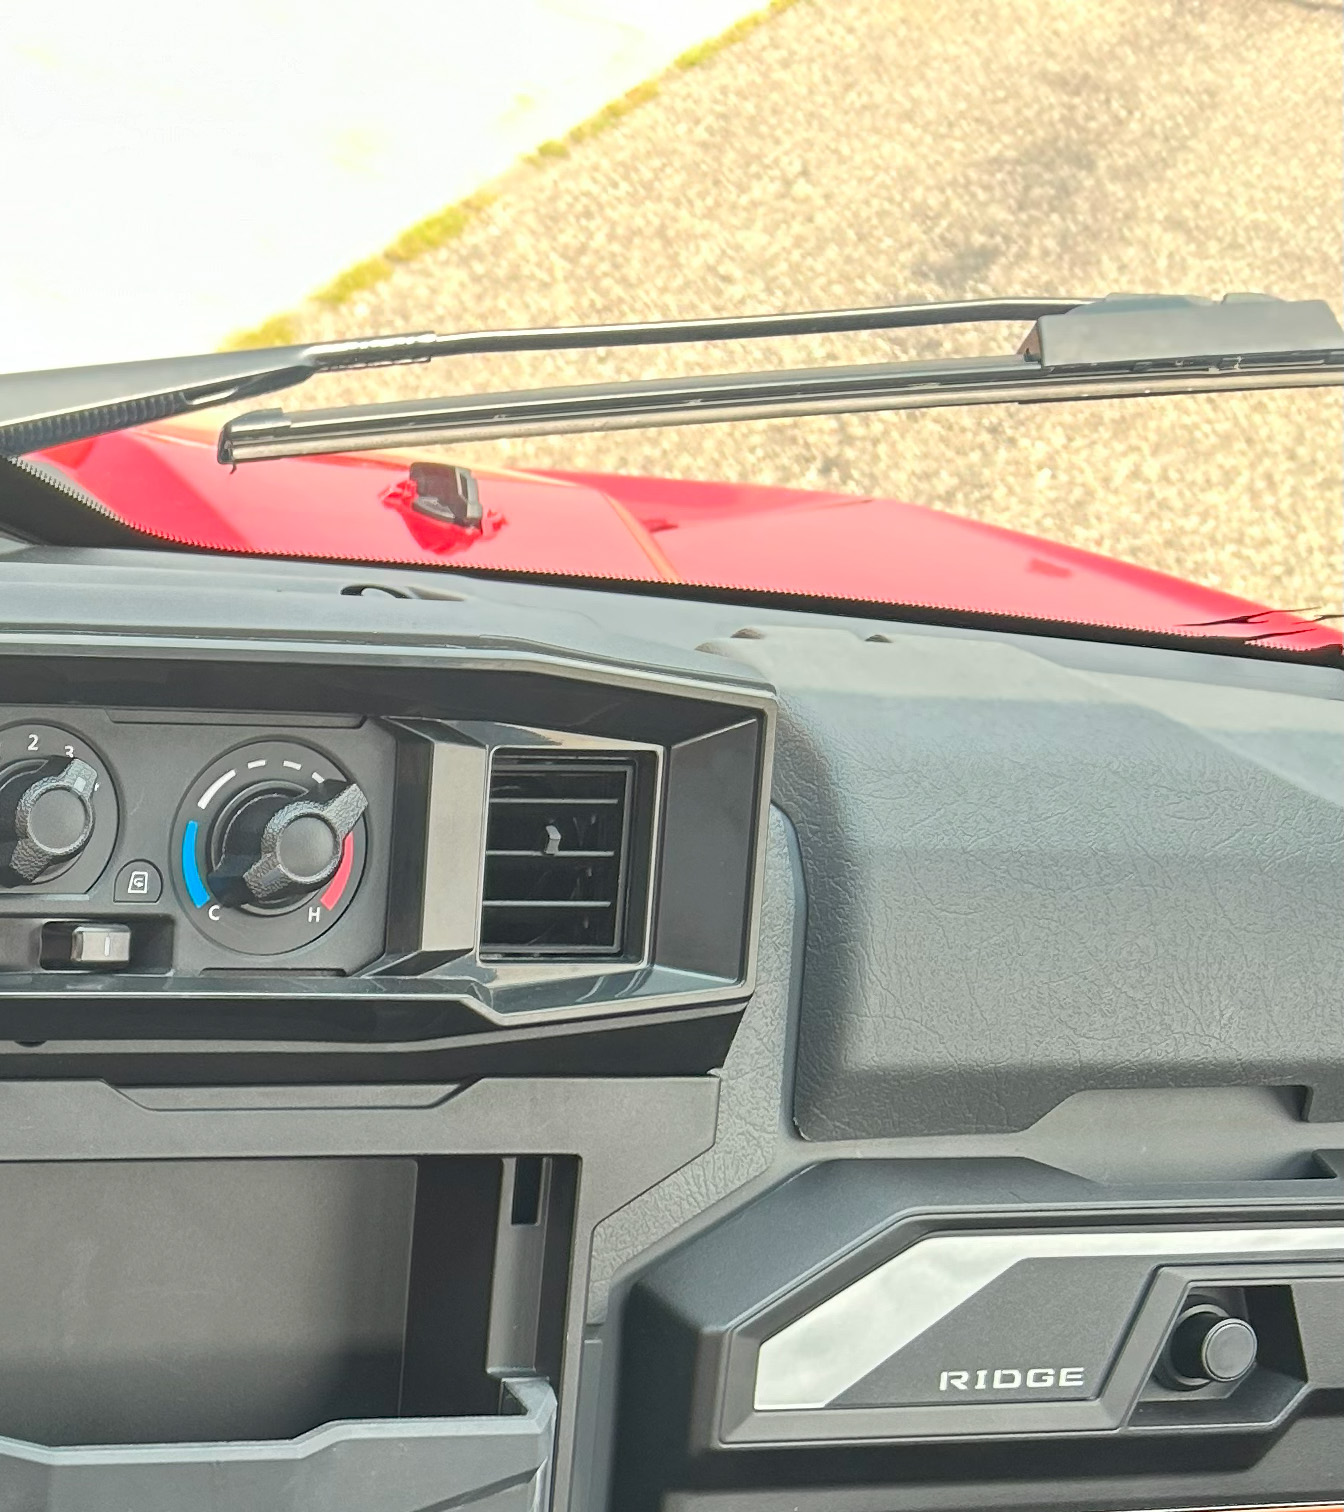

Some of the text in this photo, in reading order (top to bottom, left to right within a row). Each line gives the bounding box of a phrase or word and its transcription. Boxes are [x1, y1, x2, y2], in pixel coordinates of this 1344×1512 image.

[27, 734, 39, 751] 2
[208, 905, 220, 921] C
[308, 906, 321, 923] H
[938, 1366, 1085, 1392] RIDGE
